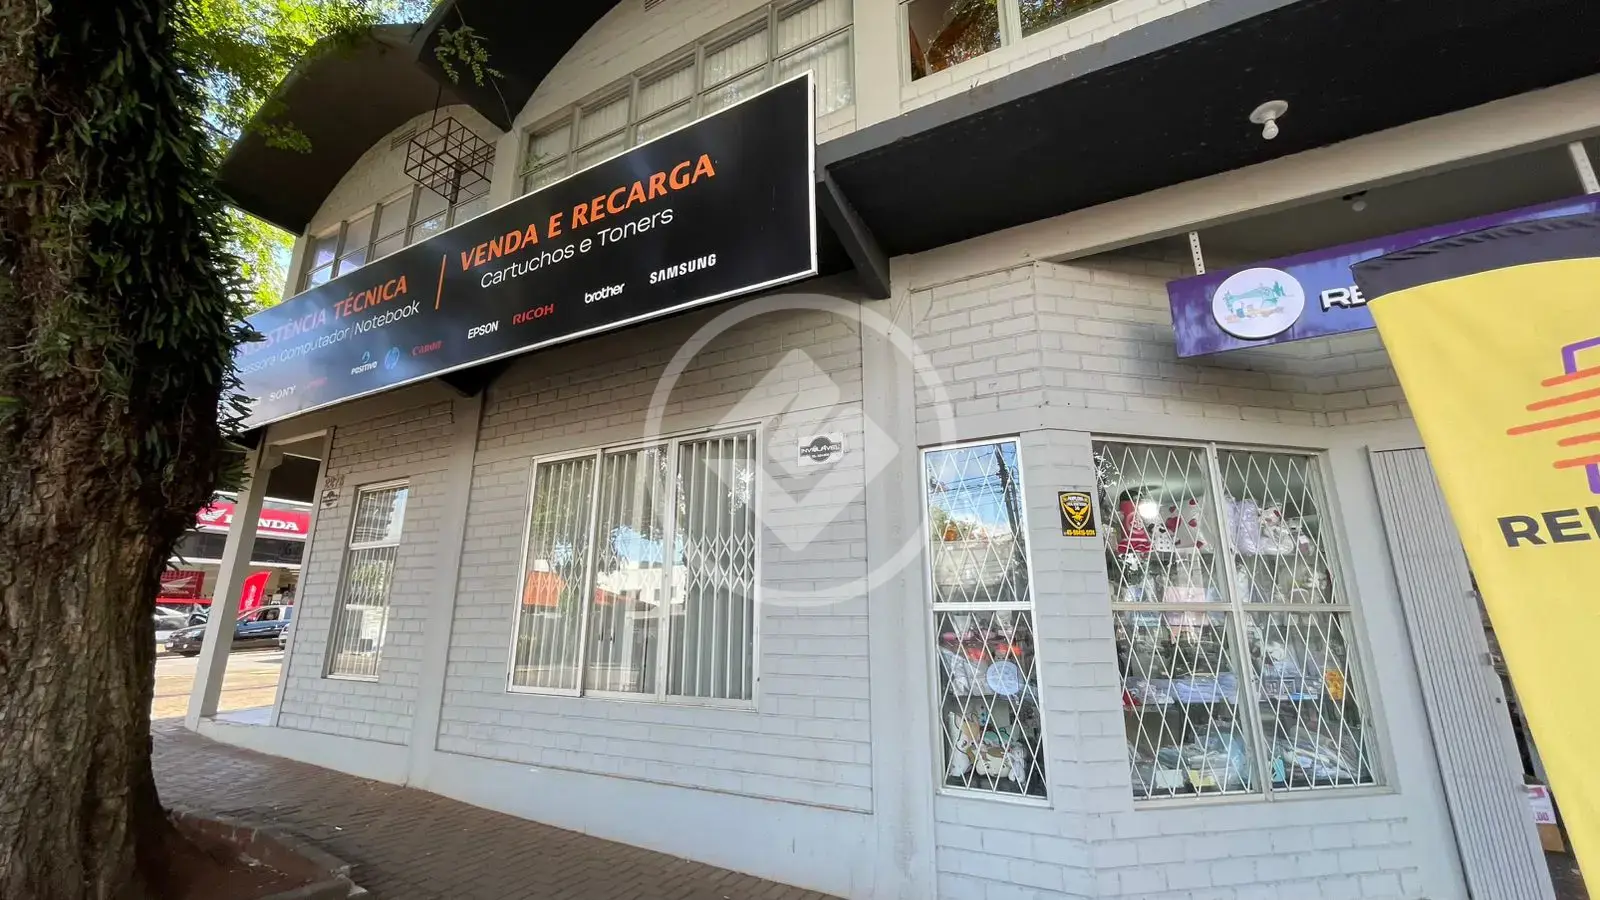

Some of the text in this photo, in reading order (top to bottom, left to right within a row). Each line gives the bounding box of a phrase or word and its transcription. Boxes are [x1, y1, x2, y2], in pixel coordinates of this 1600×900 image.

[460, 153, 716, 272] VENDA E RECARGA
[480, 208, 674, 288] Cartuchos e Toners
[649, 253, 717, 285] SAMSUNG
[333, 275, 408, 320] TÉCNICA
[584, 282, 625, 304] brother
[1320, 285, 1366, 309] RE
[354, 299, 420, 335] Notebook
[512, 303, 554, 325] RICOH
[467, 320, 499, 339] EPSON
[351, 360, 378, 376] POSITIVO
[269, 384, 297, 401] SONY
